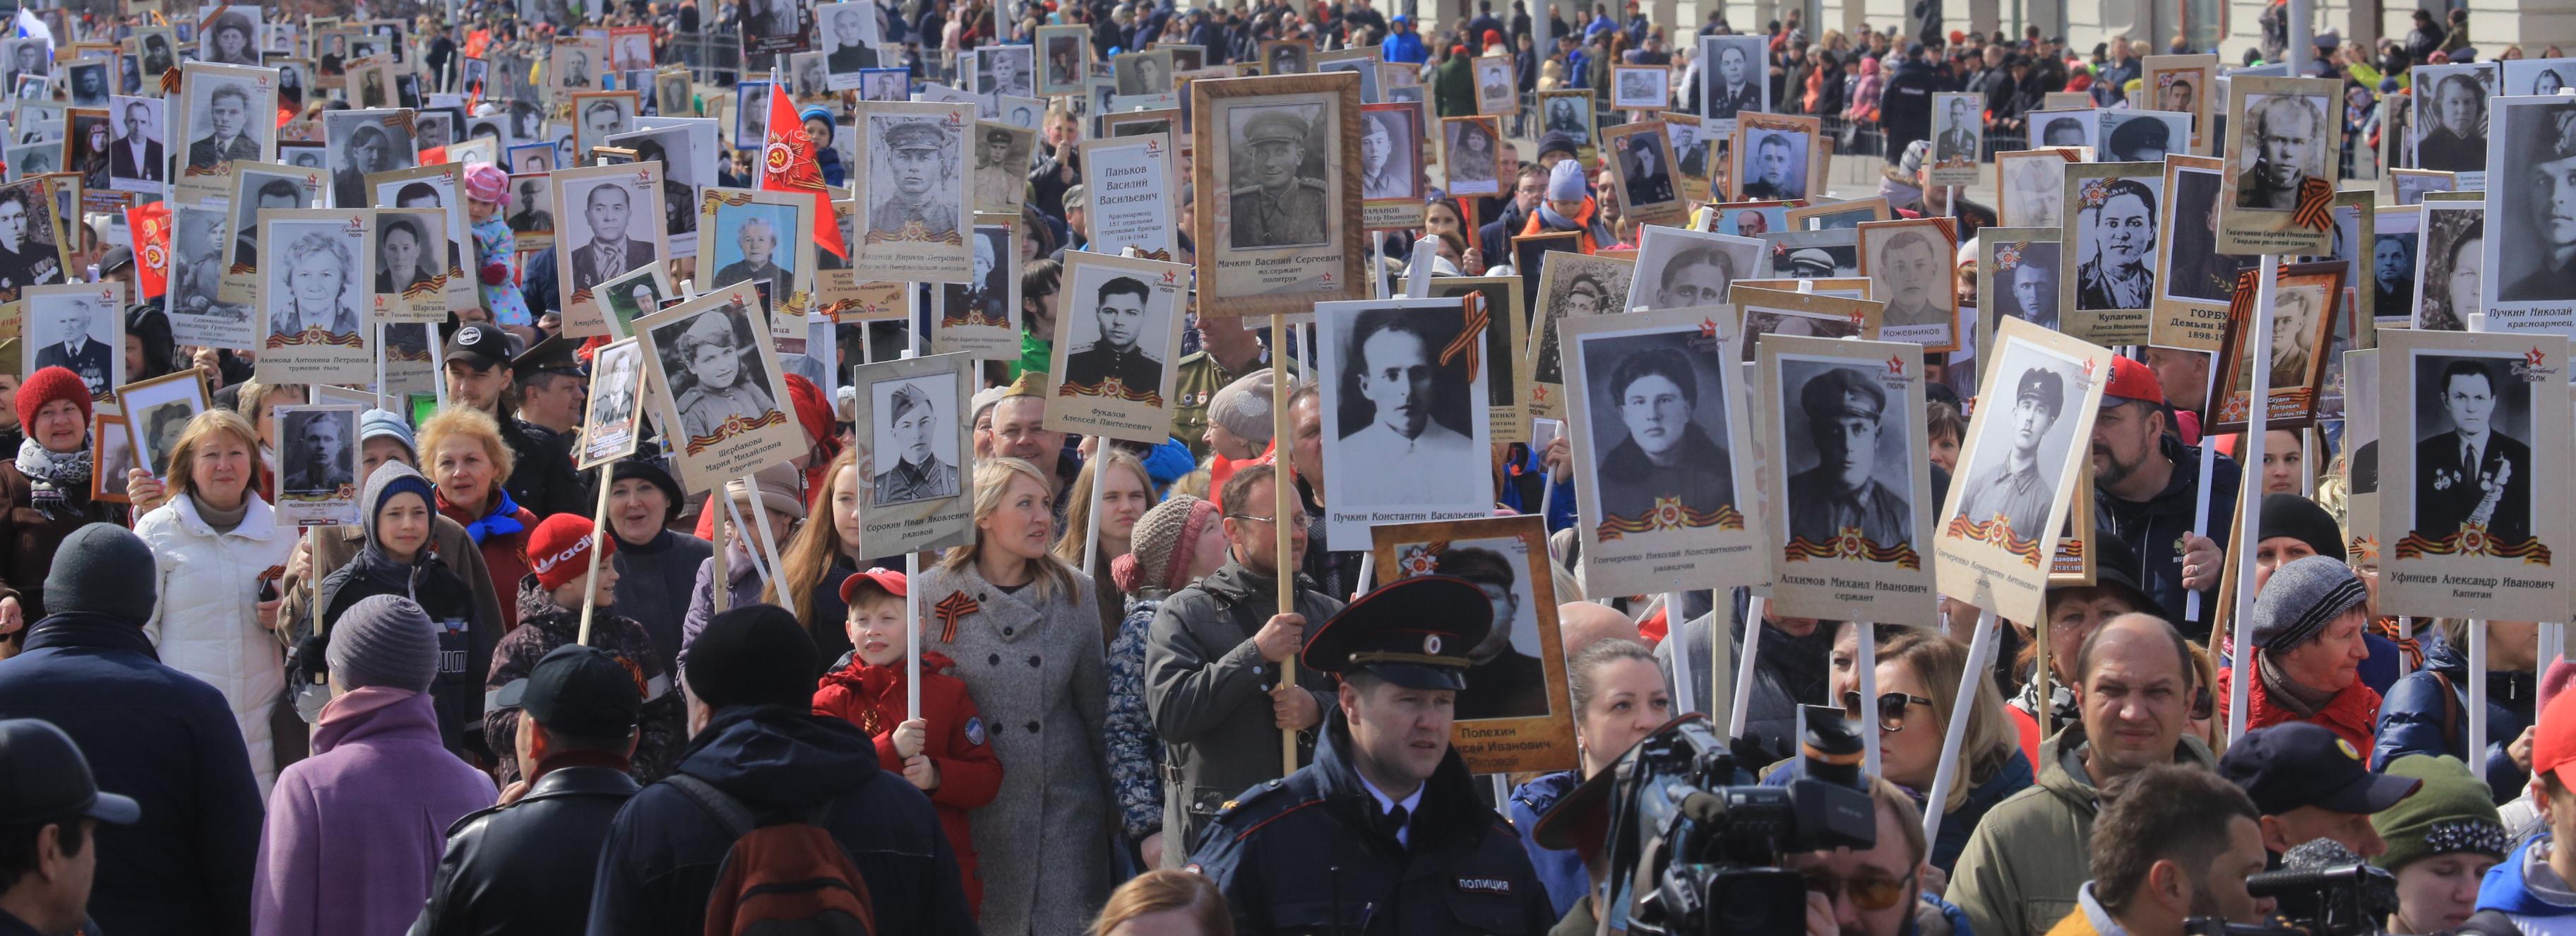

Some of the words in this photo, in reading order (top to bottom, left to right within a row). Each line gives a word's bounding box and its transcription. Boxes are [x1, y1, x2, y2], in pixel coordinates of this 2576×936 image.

[1105, 165, 1147, 177] Паньков
[1107, 178, 1148, 191] Василий
[1099, 191, 1158, 206] Васильевич
[1108, 211, 1152, 220] Красноармеец
[1101, 227, 1135, 235] стрелковая
[2263, 230, 2286, 239] Сергей
[927, 254, 965, 263] Петрович
[1217, 257, 1251, 268] Мачкин
[1255, 256, 1292, 266] Василий
[1295, 254, 1342, 266] Сергеевич
[1257, 267, 1303, 276] мл.сержант
[1262, 275, 1298, 283] политрук
[412, 304, 446, 313] Шаргаева
[2489, 307, 2526, 319] Пучкин
[2530, 306, 2572, 318] Николай
[2099, 312, 2142, 322] Кулагина
[2170, 318, 2214, 330] Демьян
[1883, 326, 1940, 338] Кожевников
[333, 356, 369, 365] Петровна
[1091, 407, 1126, 418] Фукалов
[1061, 414, 1096, 425] Алексей
[1099, 418, 1152, 431] Пантелеевич
[717, 437, 763, 458] Щербакова
[705, 459, 731, 473] Мария
[734, 440, 782, 463] Михайловна
[729, 458, 764, 474] Ефрейтор
[866, 521, 902, 533] Сорокин
[904, 518, 924, 528] Иван
[927, 511, 970, 524] Яковлевич
[1333, 512, 1367, 523] Пучкин
[1371, 511, 1427, 521] Константин
[1431, 511, 1486, 521] Васильевич
[902, 528, 934, 540] рядовой
[1593, 554, 1643, 565] Гончеренко
[1645, 550, 1681, 560] Николай
[1684, 544, 1753, 557] Константинович
[1653, 562, 1695, 573] разведчик
[1971, 560, 2005, 579] Константин
[2005, 574, 2039, 592] Антонович
[2390, 571, 2438, 585] Уфинцев
[2442, 574, 2498, 588] Александр
[2503, 576, 2555, 589] Иванович
[1780, 573, 1826, 587] Алхимов
[1830, 578, 1871, 590] Михаил
[1875, 581, 1928, 595] Иванович
[1834, 592, 1875, 603] сержант
[2452, 588, 2493, 599] Капитан
[1461, 726, 1516, 739] Полехин
[1487, 740, 1551, 752] Иванович
[1459, 878, 1510, 892] ПОЛИЦИЯ
